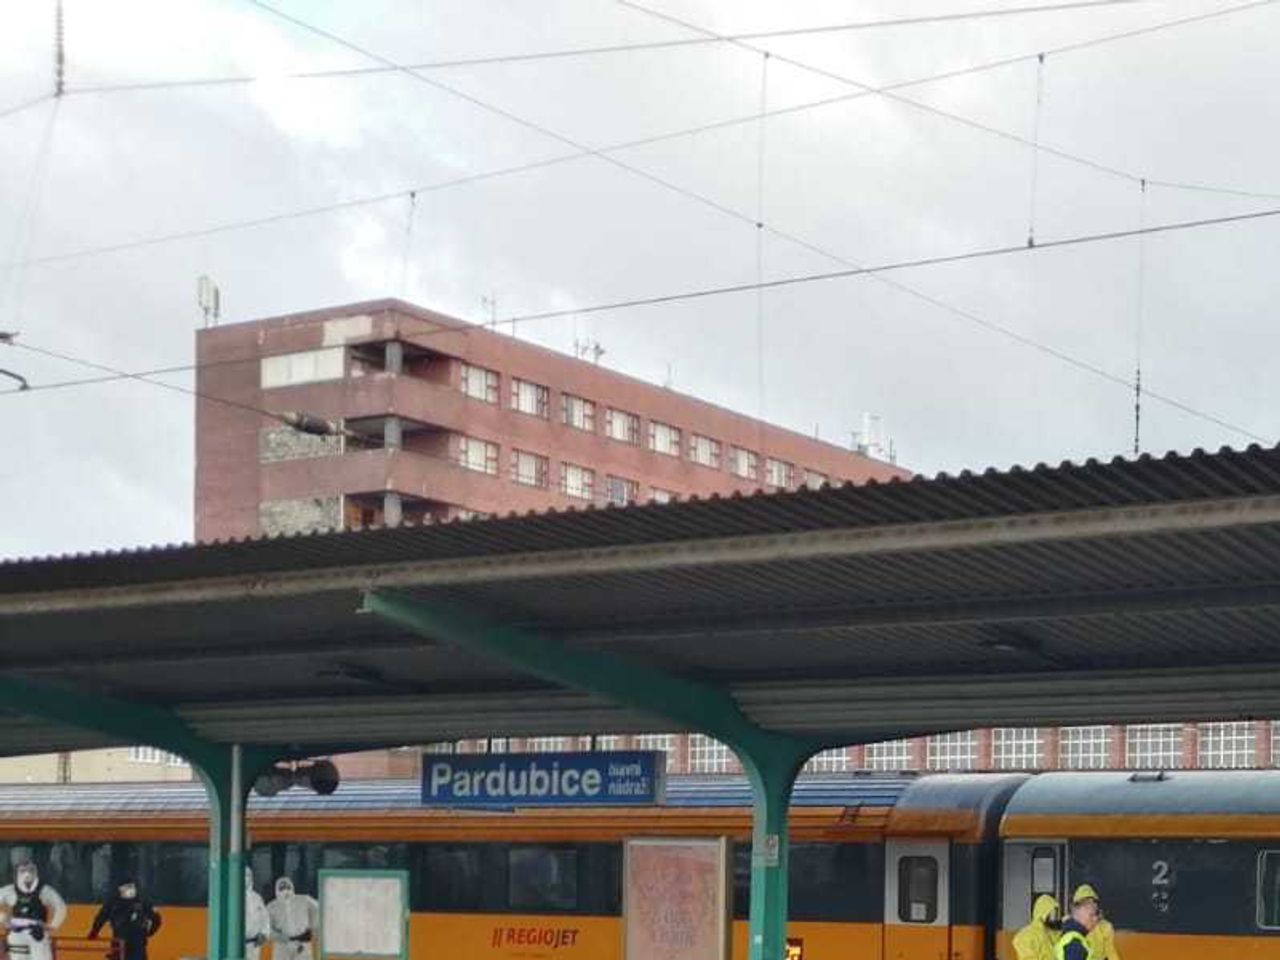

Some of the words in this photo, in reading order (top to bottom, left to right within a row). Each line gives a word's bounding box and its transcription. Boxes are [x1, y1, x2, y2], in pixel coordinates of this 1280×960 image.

[431, 763, 602, 797] Pardubice
[1152, 860, 1168, 885] 2
[506, 927, 579, 948] REGIOJET
